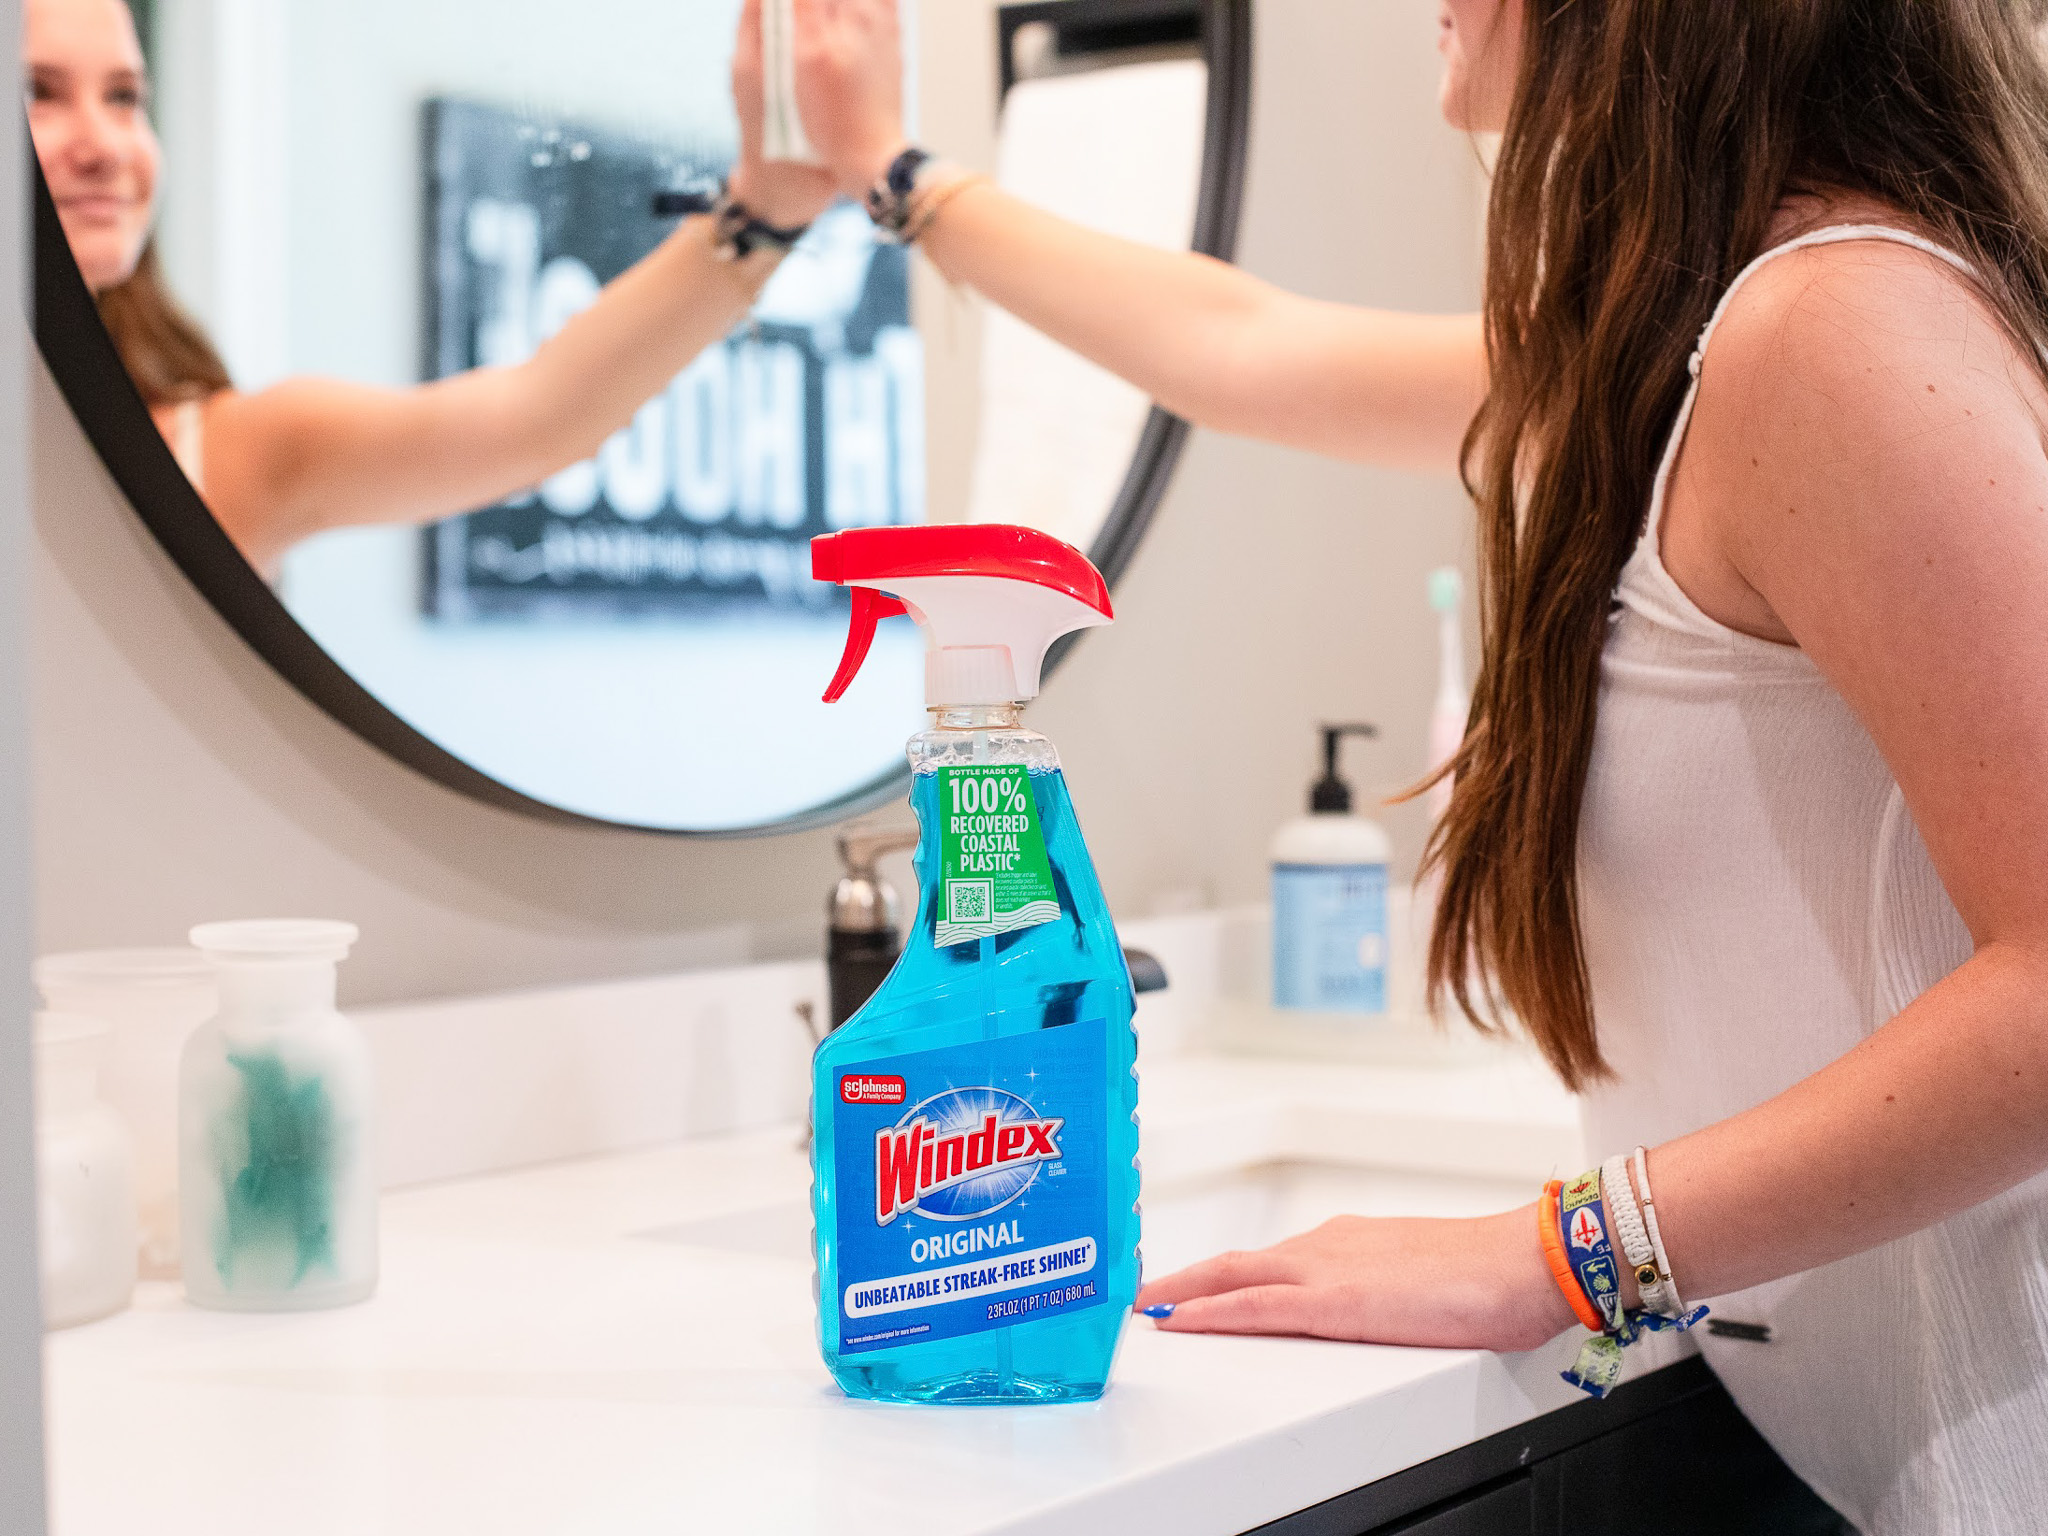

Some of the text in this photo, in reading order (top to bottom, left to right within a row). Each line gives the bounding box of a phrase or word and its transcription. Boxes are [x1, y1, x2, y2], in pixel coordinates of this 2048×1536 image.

[949, 777, 1027, 814] 100%
[950, 815, 1029, 834] RECOVERED
[960, 834, 1020, 853] COASTAL
[881, 1093, 902, 1101] Company
[877, 1112, 1060, 1219] Windex
[910, 1220, 1025, 1263] ORIGINAL
[854, 1281, 941, 1309] UNBEATABLE
[944, 1261, 1036, 1293] STREAK-FREE
[1042, 1293, 1048, 1307] 7
[1049, 1289, 1064, 1307] OZ)
[1065, 1285, 1082, 1302] 680
[1083, 1281, 1096, 1297] mL
